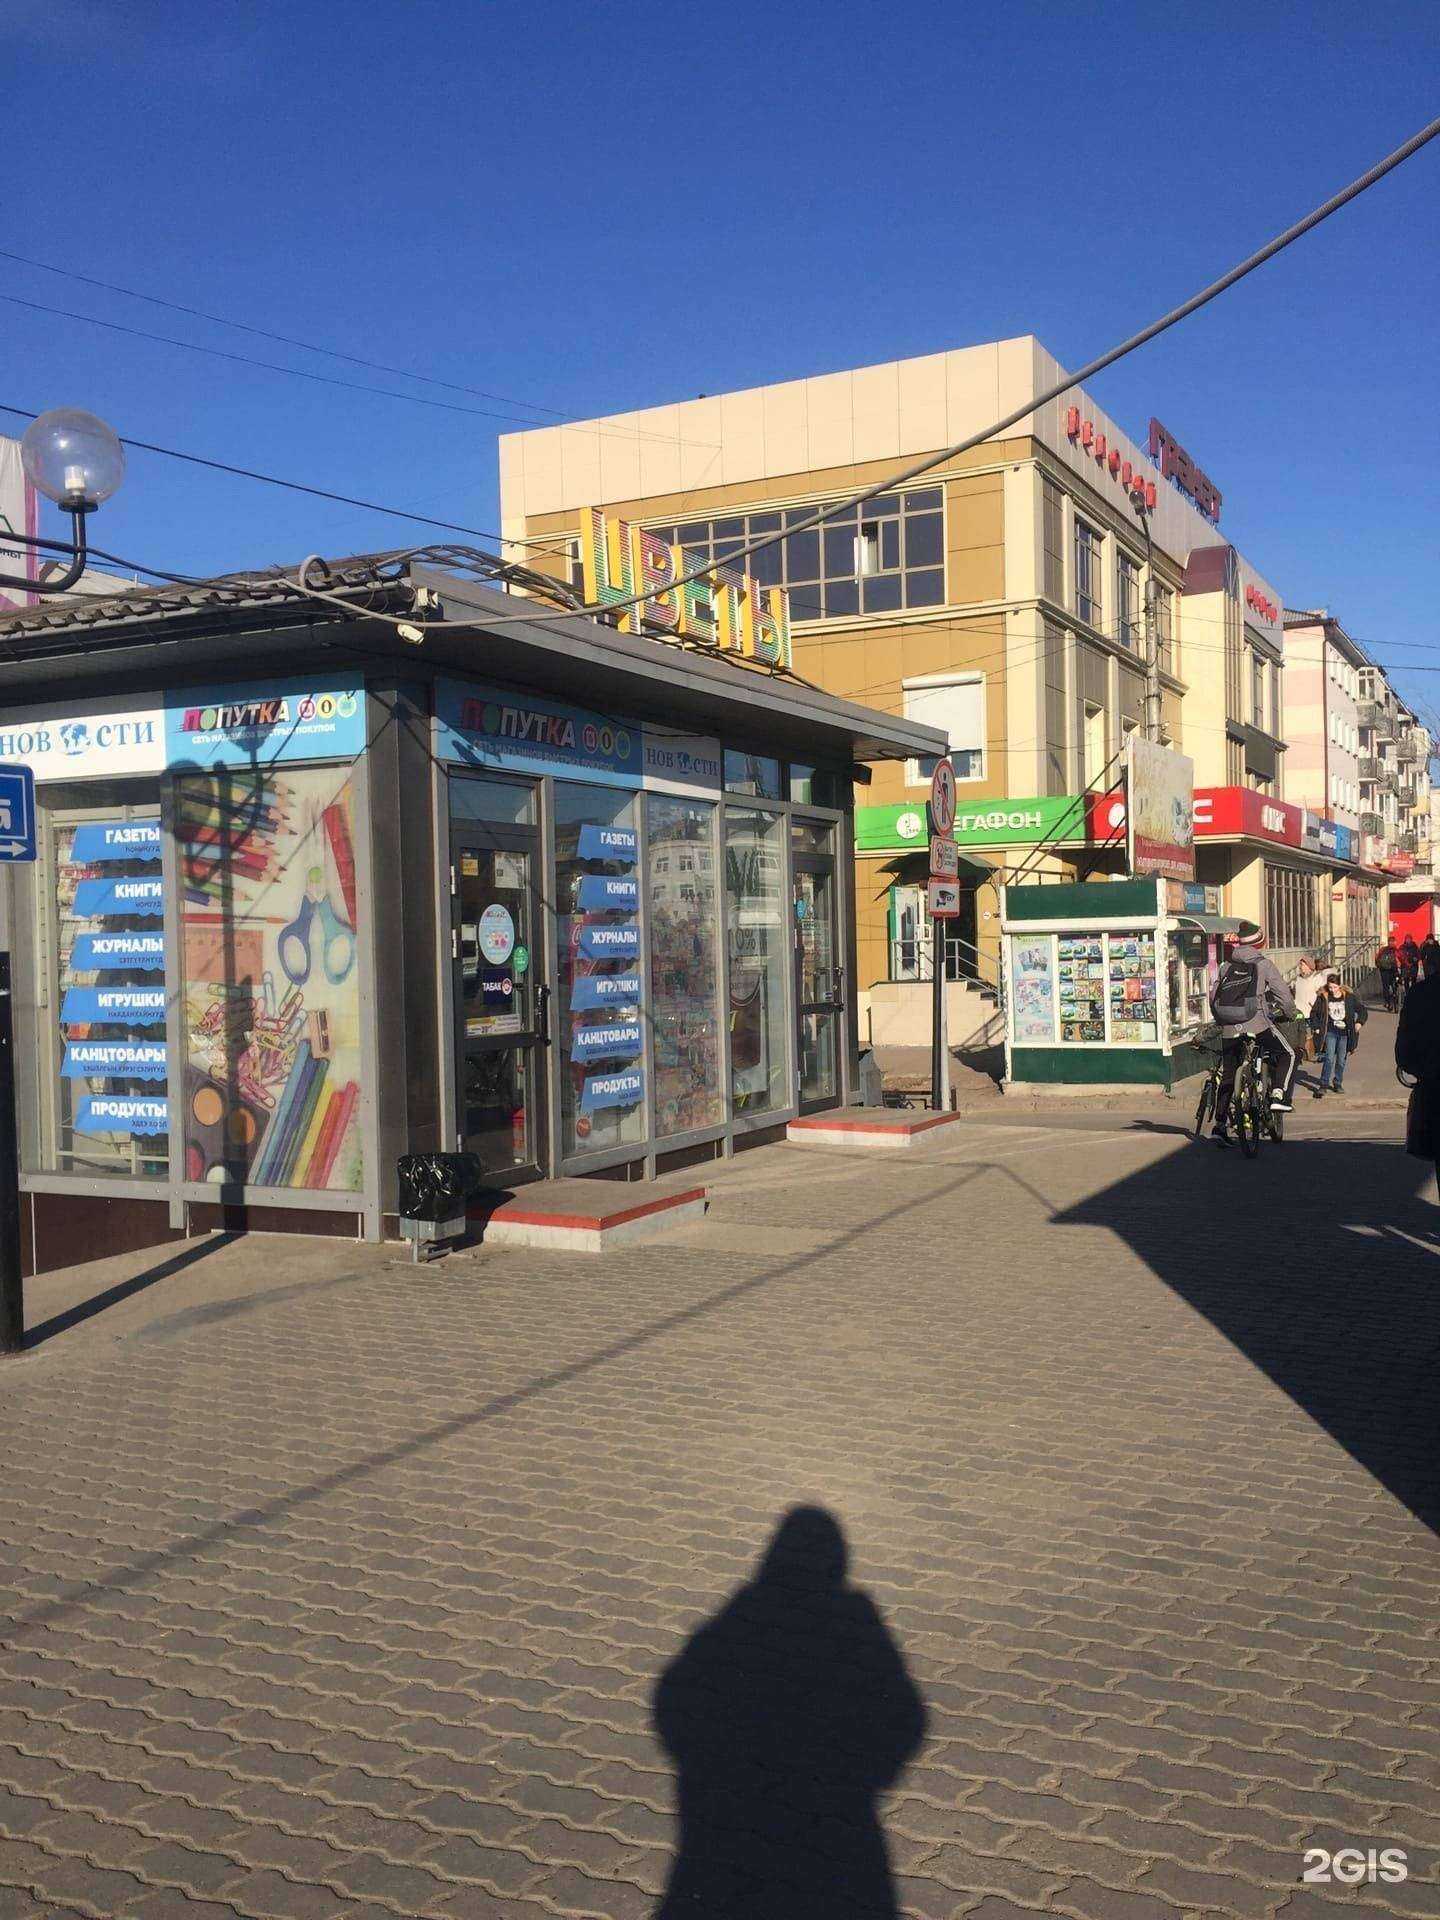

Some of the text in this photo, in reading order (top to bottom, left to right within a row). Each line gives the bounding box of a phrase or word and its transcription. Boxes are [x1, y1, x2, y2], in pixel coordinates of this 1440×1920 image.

[580, 506, 792, 669] ЦВЕТЫ
[182, 700, 290, 732] ПОПУТКА
[462, 698, 577, 749] ПОПУТКА
[952, 811, 1042, 832] ЕГАФОН
[105, 827, 160, 844] ГАЗЕТЫ
[600, 832, 635, 846] ГАЗЕТЫ
[115, 882, 162, 898] КНИГИ
[606, 881, 636, 895] КНИГИ
[592, 931, 637, 944] ЖУРНАЛЫ
[92, 938, 163, 954] ЖУРНАЛЫ
[596, 979, 639, 994] ИГРУШКИ
[98, 993, 165, 1007] ИГРУШКИ
[578, 1028, 639, 1046] КАНЦТОВАРЫ
[70, 1047, 166, 1063] КАНЦТОВАРЫ
[592, 1076, 640, 1095] ПРОДУКТЫ
[91, 1101, 167, 1118] ПРОДУКТЫ
